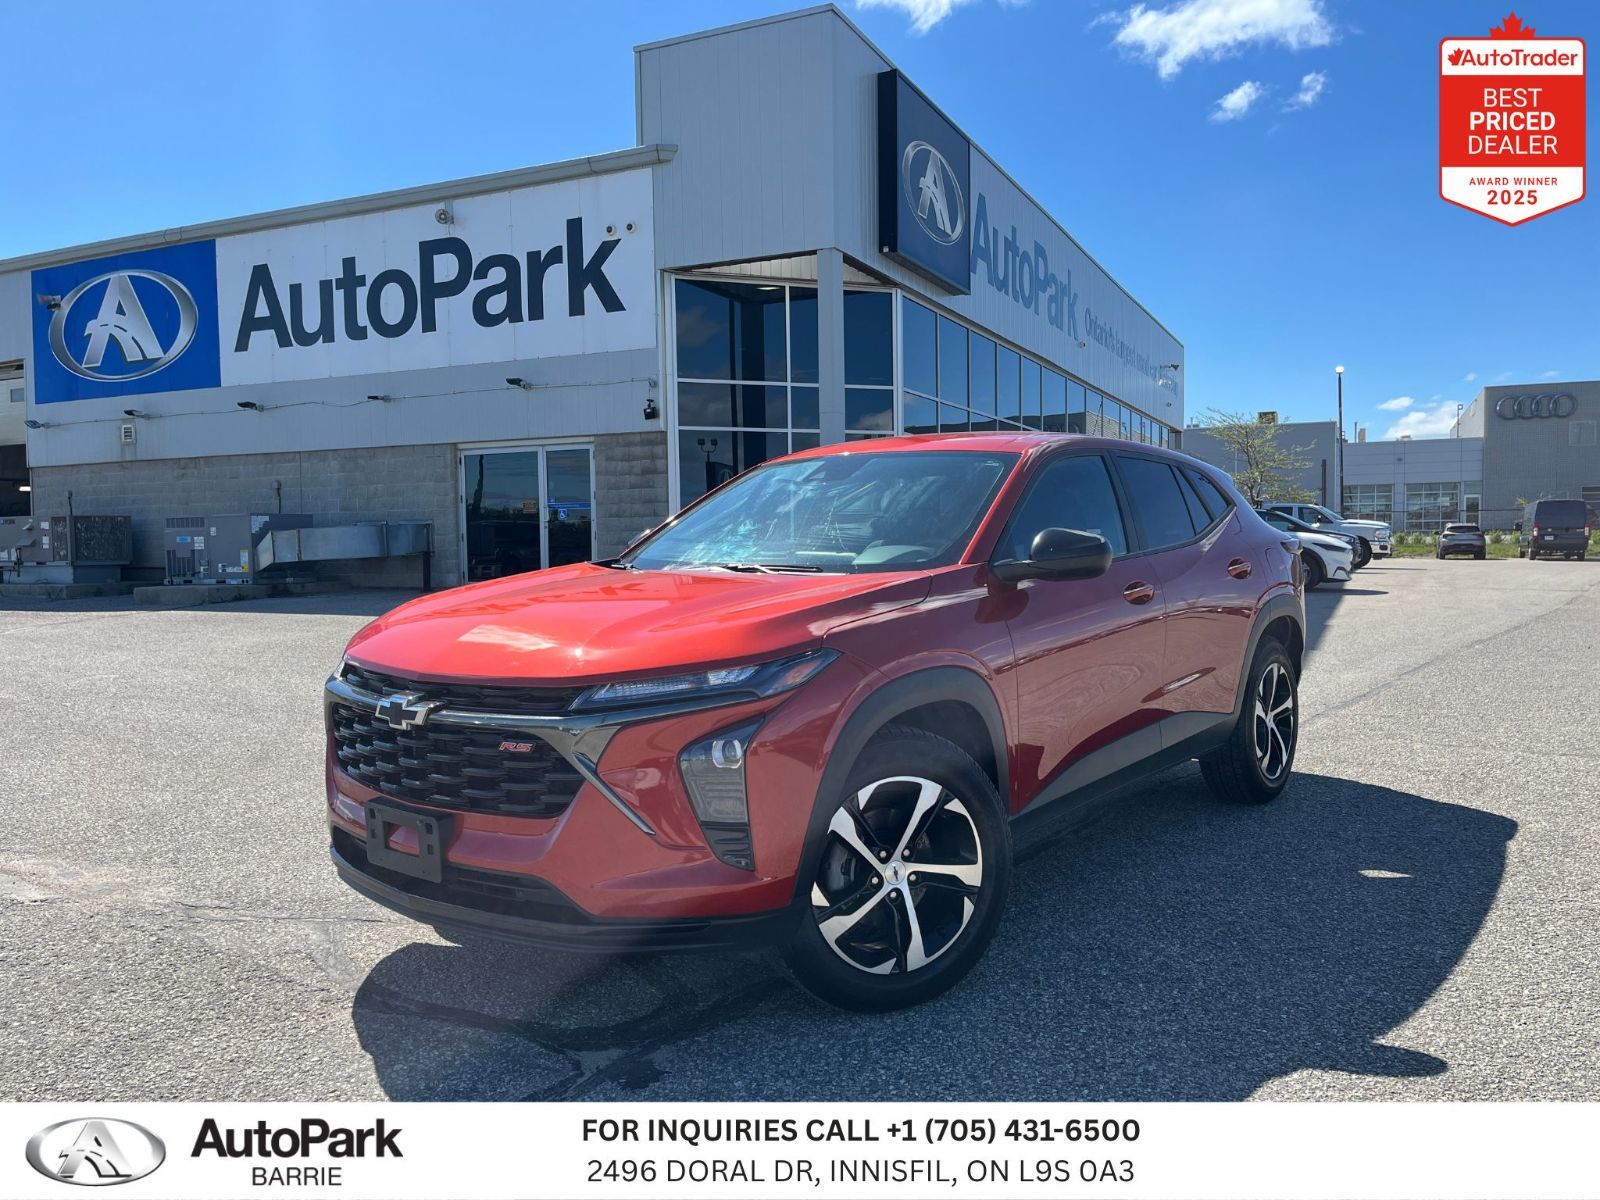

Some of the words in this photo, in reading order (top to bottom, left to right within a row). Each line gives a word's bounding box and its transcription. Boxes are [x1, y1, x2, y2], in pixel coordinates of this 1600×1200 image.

[235, 217, 627, 353] AutoPark
[970, 192, 1079, 342] AutoPark
[499, 741, 533, 752] RS
